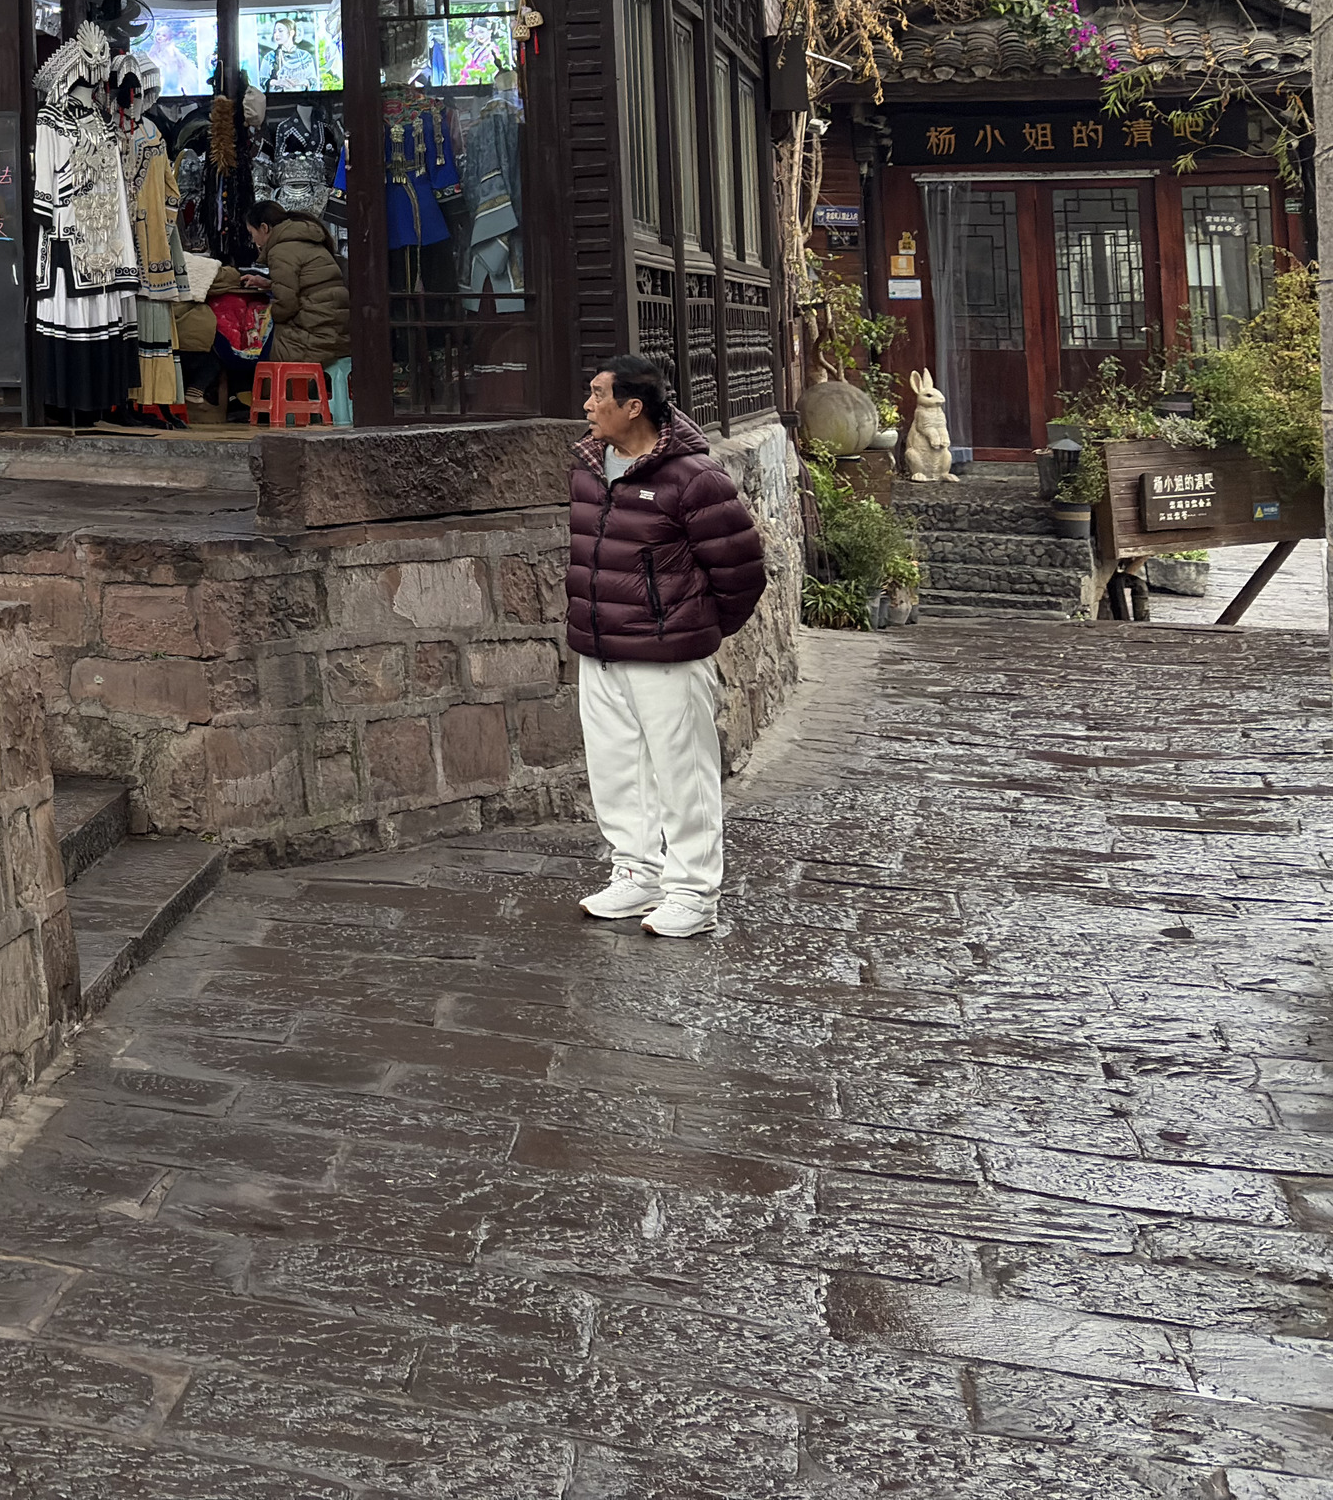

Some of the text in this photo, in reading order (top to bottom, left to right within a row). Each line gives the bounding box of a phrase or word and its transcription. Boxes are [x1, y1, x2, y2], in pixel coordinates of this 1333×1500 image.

[926, 117, 1206, 156] 杨小姐的清吧
